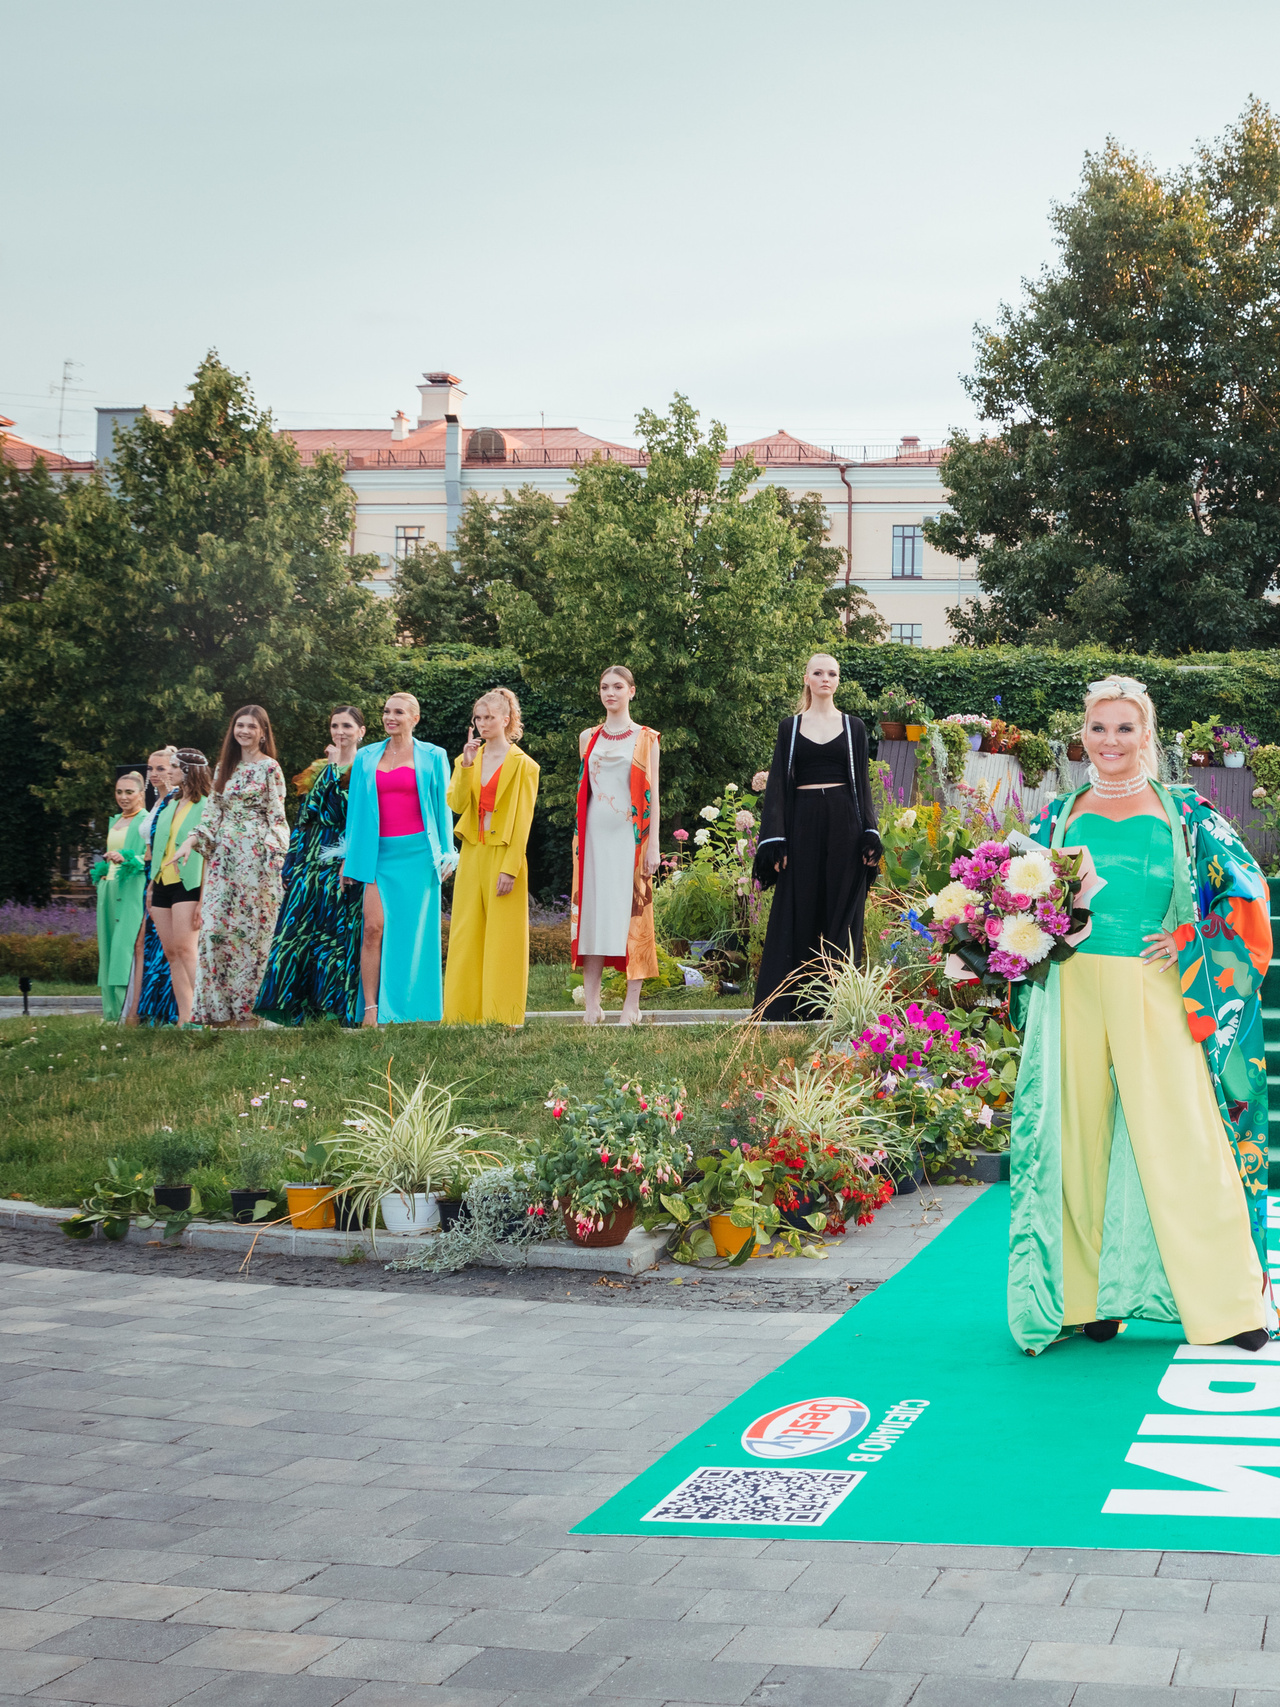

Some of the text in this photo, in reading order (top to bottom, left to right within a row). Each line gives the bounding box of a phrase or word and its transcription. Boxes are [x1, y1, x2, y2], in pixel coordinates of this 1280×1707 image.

[747, 1401, 851, 1451] bestly
[846, 1399, 931, 1463] СДЕЛАНО В
